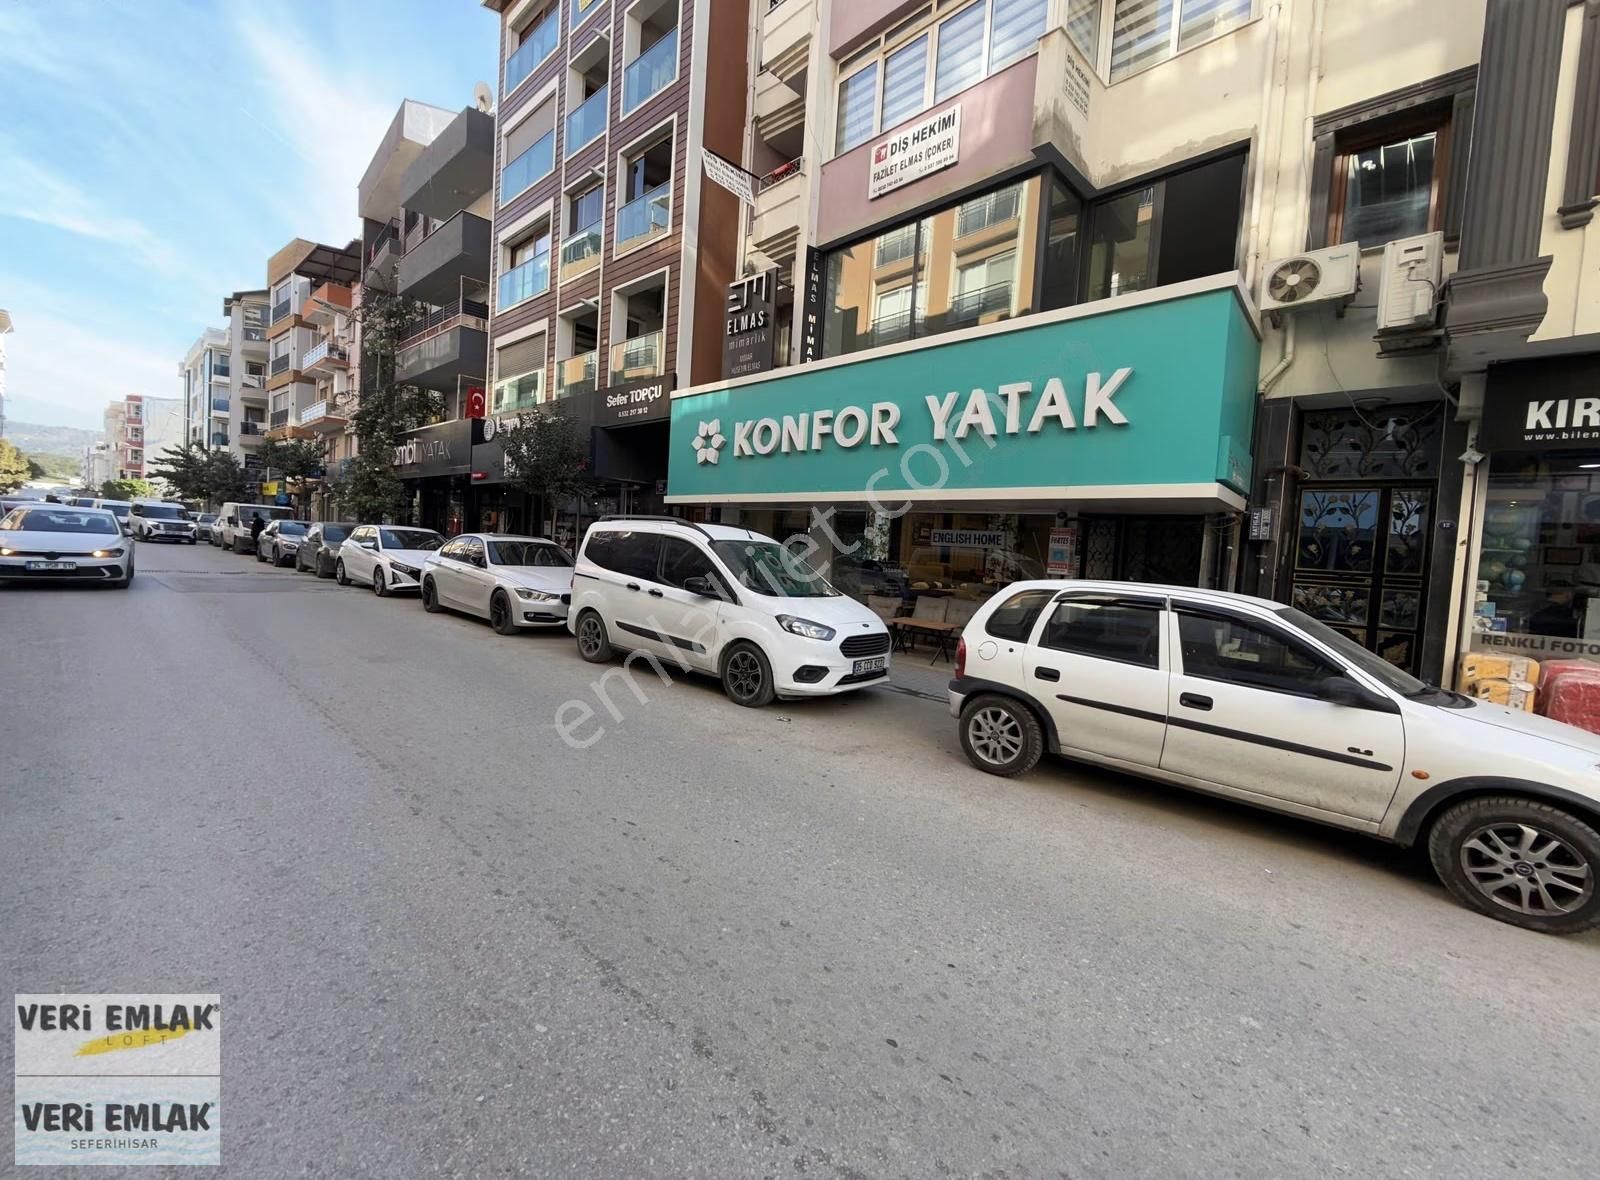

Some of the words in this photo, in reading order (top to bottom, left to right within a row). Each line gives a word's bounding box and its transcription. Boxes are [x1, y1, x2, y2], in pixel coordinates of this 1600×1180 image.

[890, 136, 908, 156] DİŞ
[912, 109, 956, 146] HEKİMİ
[873, 162, 898, 183] FAZİLET
[899, 151, 923, 171] ELMAS
[727, 310, 764, 335] ELMAS
[606, 393, 629, 408] Sefer
[629, 384, 662, 403] TOPÇU
[733, 401, 900, 457] KONFOR
[924, 366, 1136, 440] YATAK
[1526, 397, 1600, 429] KIR
[1524, 431, 1600, 441] www.bilen
[932, 531, 971, 545] ENGLISH
[973, 533, 1003, 546] HOME
[1481, 634, 1545, 650] RENKLİ
[1550, 640, 1600, 656] FOTO
